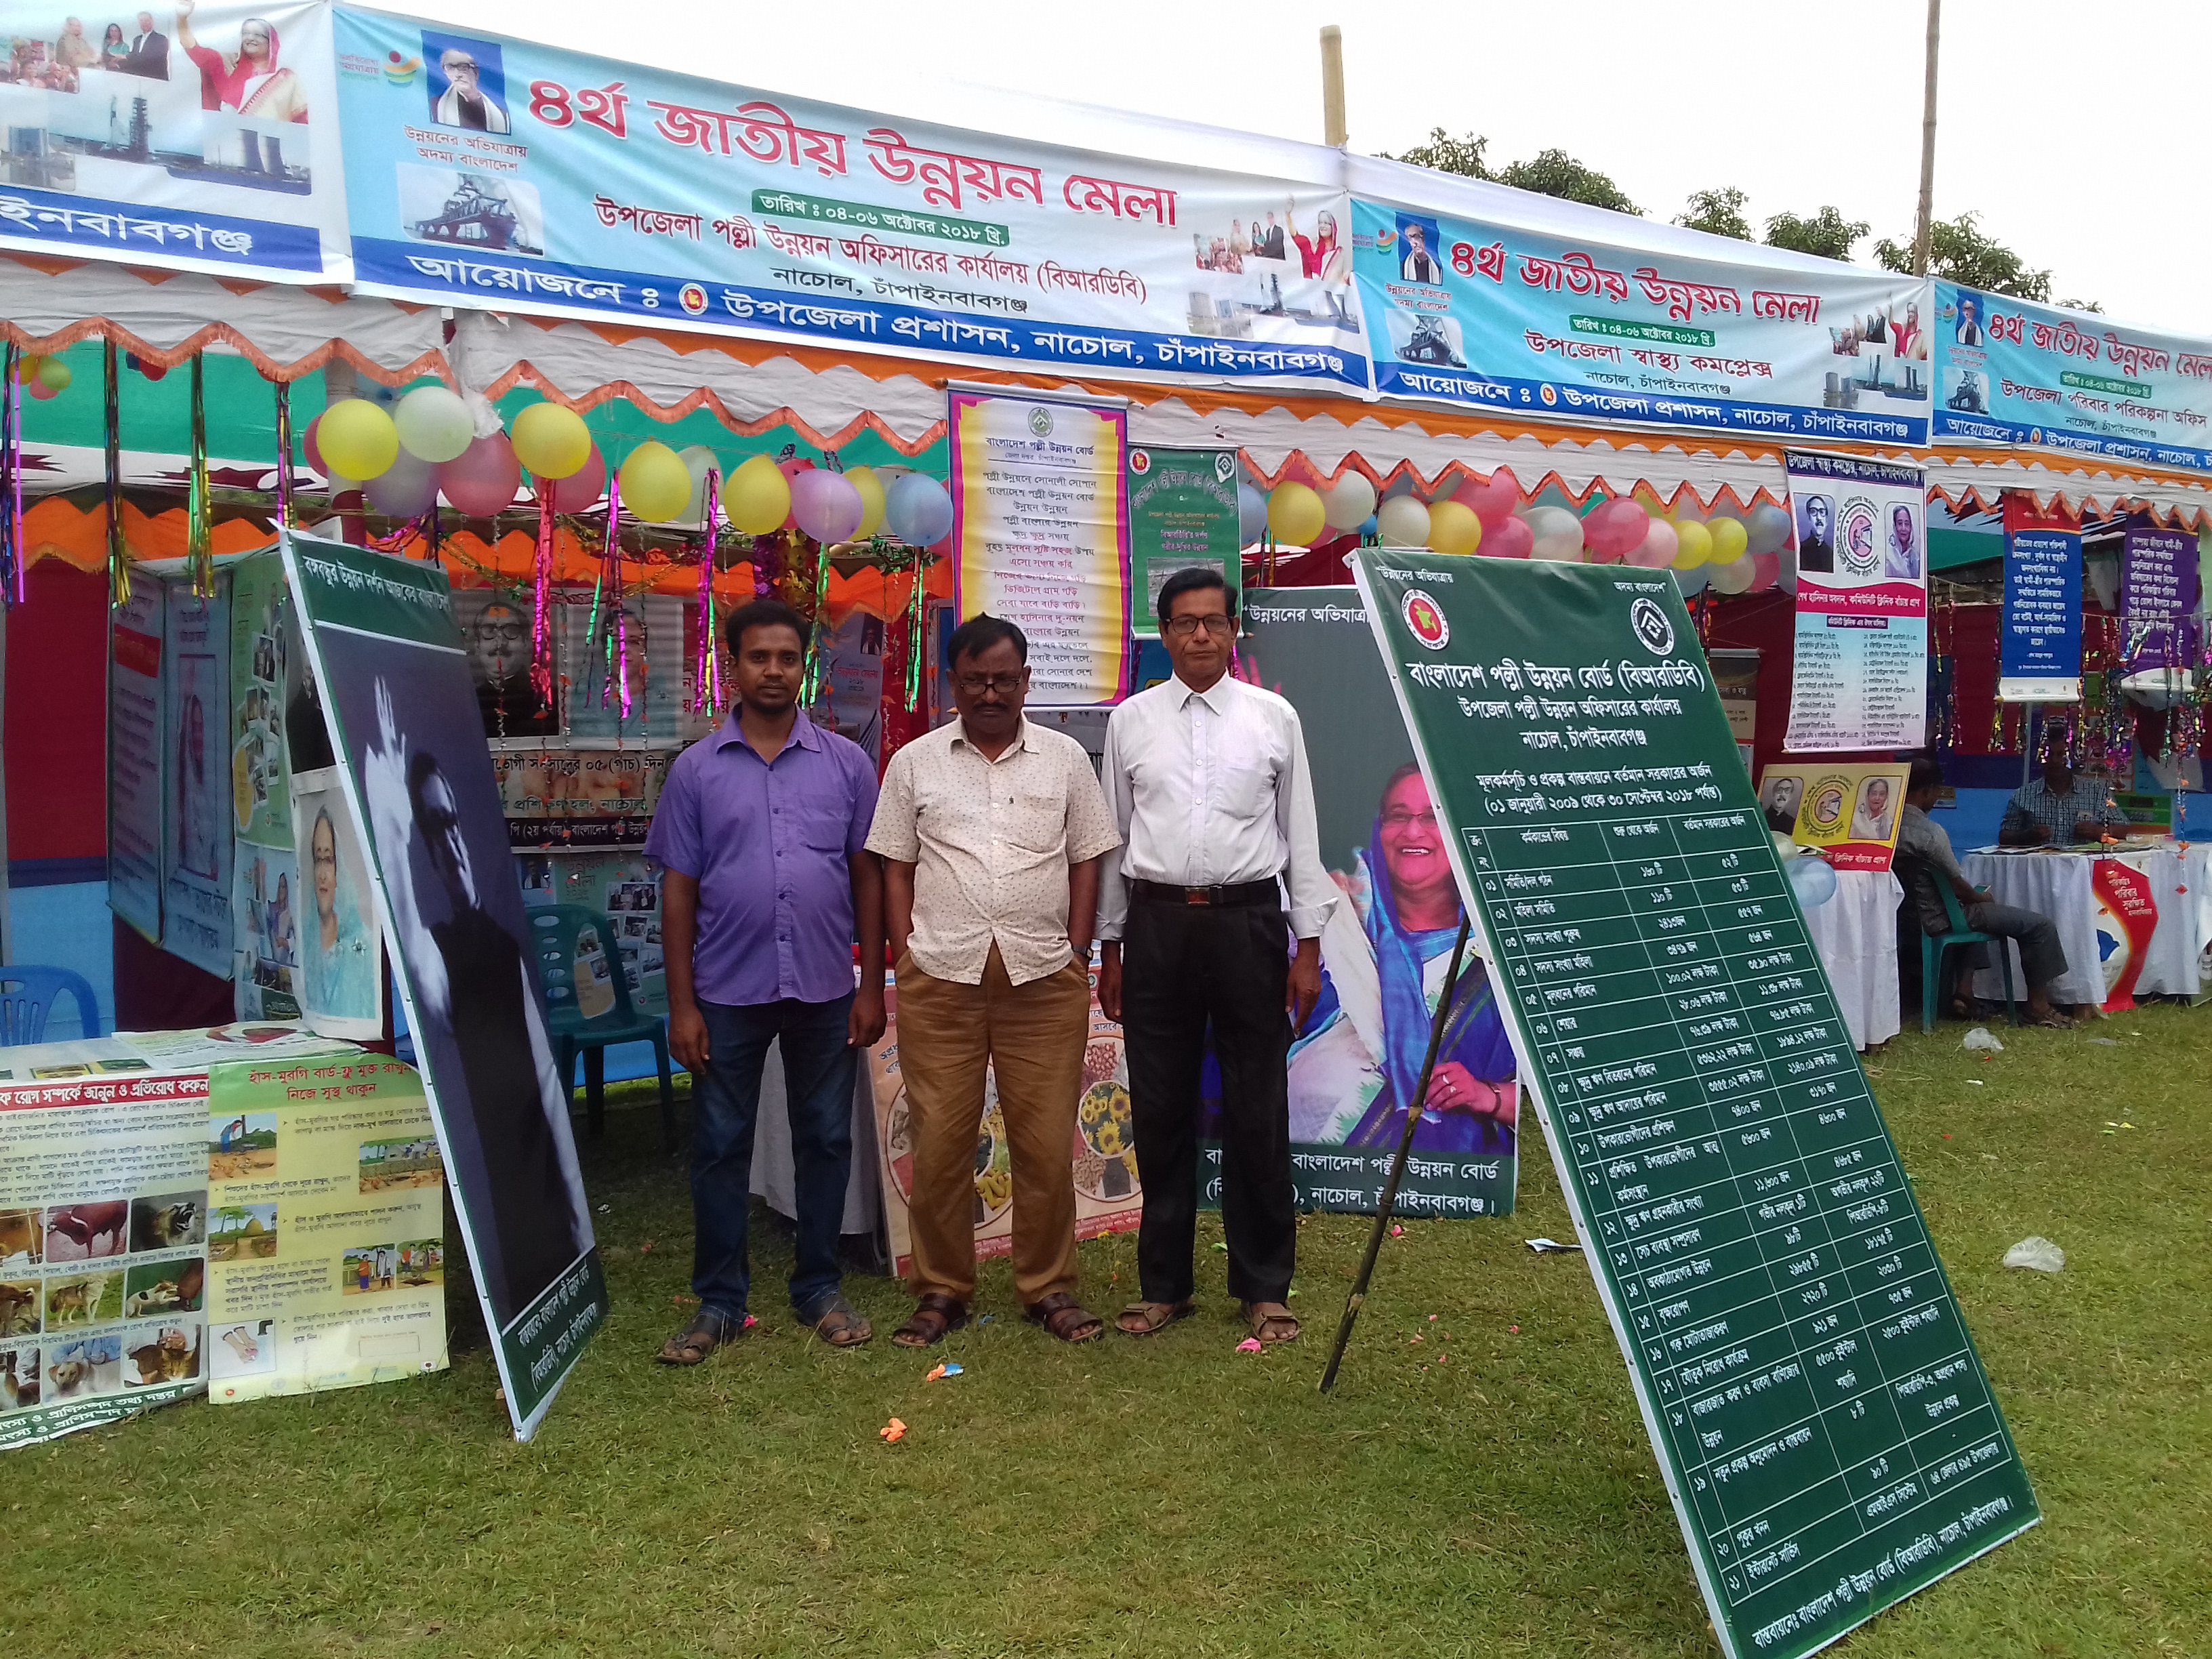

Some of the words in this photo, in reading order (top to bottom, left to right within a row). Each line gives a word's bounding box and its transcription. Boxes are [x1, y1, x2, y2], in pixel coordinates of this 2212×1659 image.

[405, 125, 458, 146] উন্নয়নের
[466, 136, 528, 158] অভিযাত্রায়
[417, 148, 454, 163] অদম্য
[459, 154, 518, 172] বাংলাদেশ
[530, 81, 628, 137] ৪র্থ
[650, 102, 846, 174] জাতীয়
[864, 128, 1042, 208] উন্নয়ন
[1063, 175, 1176, 225] মেলা
[0, 194, 253, 256] ইনবাবগঞ্জ
[759, 194, 806, 215] তারিখ
[825, 207, 878, 225] ০৪-০৬
[881, 213, 935, 233] অক্টোবর
[941, 222, 981, 239] ২০১৮
[594, 194, 703, 239] উপজেলা
[712, 216, 756, 249] পল্লী
[763, 221, 832, 259] উন্নয়ন
[838, 234, 947, 272] অফিসারের
[954, 251, 1029, 284] কার্যালয়
[1037, 260, 1146, 304] (বিআরডিবি)
[771, 268, 863, 295] নাচোল,
[874, 278, 1027, 312] চাঁপাইনবাবগঞ্জ
[1452, 243, 1505, 281] ৪র্থ
[1519, 252, 1627, 300] জাতীয়
[1632, 268, 1740, 321] উন্নয়ন
[1752, 291, 1820, 323] মেলা
[407, 256, 624, 303] আয়োজনে
[724, 289, 881, 333] উপজেলা
[891, 317, 1020, 352] প্রশাসন,
[1031, 332, 1143, 363] নাচোল,
[1150, 329, 1346, 385] চাঁপাইনবাবগঞ্জ
[1573, 318, 1599, 331] তারিখ
[1610, 325, 1639, 337] ০৪-০৬
[1675, 332, 1698, 344] ২০১৮
[1524, 329, 1621, 363] উপজেলা
[1629, 349, 1681, 373] স্বাস্থ্য
[1686, 355, 1772, 378] কমপ্লেক্স
[1988, 313, 2025, 344] ৪র্থ
[2032, 321, 2099, 360] জাতীয়
[2103, 332, 2170, 377] উন্নয়ন
[2176, 353, 2212, 380] মেল
[1584, 371, 1635, 389] নাচোল,
[1639, 374, 1731, 395] চাঁপাইনবাবগঞ্জ
[1399, 372, 1511, 400] আয়োজনে
[1562, 387, 1650, 414] উপজেলা
[1655, 401, 1727, 424] প্রশাসন,
[1732, 408, 1795, 430] নাচোল,
[1803, 411, 1908, 437] চাঁপাইনবাবগঞ্জ
[2001, 378, 2062, 405] উপজেলা
[2068, 391, 2109, 413] পরিবার
[2114, 399, 2168, 422] পরিকল্পনা
[2172, 409, 2207, 428] অফিস
[1946, 418, 2012, 440] আয়োজনে
[2046, 431, 2100, 455] উপজেলা
[1406, 662, 1487, 689] বাংলাদেশ
[1490, 658, 1524, 691] পল্লী
[1523, 659, 1575, 692] উন্নয়ন
[1578, 659, 1613, 689] বোর্ড
[1618, 659, 1704, 693] (বিআরডিবি)
[1457, 695, 1513, 718] উপজেলা
[1515, 695, 1540, 720] পল্লী
[1538, 696, 1578, 720] উন্নয়ন
[1578, 695, 1638, 717] অফিসারের
[1637, 694, 1682, 716] কার্যালয়
[1519, 731, 1568, 752] নাচোল,
[1566, 725, 1647, 748] চাঁপাইনবাবগঞ্জ
[1475, 769, 1525, 793] মূলকর্মসূচি
[1527, 774, 1538, 786] ও
[1540, 773, 1566, 787] প্রকল্প
[1565, 771, 1612, 785] বাস্তবায়নে
[1612, 765, 1645, 783] বর্তমান
[1644, 766, 1687, 781] সরকারের
[1686, 761, 1713, 778] অর্জন
[1484, 797, 1506, 817] (০১
[1506, 792, 1547, 815] জানুয়ারী
[1549, 797, 1579, 811] ২০০৯
[1581, 794, 1605, 808] থেকে
[1607, 794, 1624, 806] ৩০
[1623, 788, 1664, 805] সেপ্টেম্বর
[1665, 789, 1693, 803] ২০১৮
[1694, 783, 1722, 802] পর্যন্ত)
[14, 1090, 40, 1105] রোগ
[83, 1085, 116, 1103] জানুন
[287, 1086, 317, 1100] নিজে
[346, 1083, 377, 1097] থাকুন
[1292, 1153, 1365, 1172] বাংলাদেশ
[1406, 1155, 1456, 1179] উন্নয়ন
[1460, 1160, 1500, 1180] বোর্ড
[1797, 1591, 1837, 1623] বাংলাদেশ
[1835, 1577, 1853, 1602] পল্লী
[1849, 1569, 1878, 1593] উন্নয়ন
[1876, 1552, 1896, 1581] বোর্ড
[1937, 1521, 1967, 1543] নাচোল,
[1961, 1497, 2009, 1531] চাঁপাইনবাবগঞ্জ
